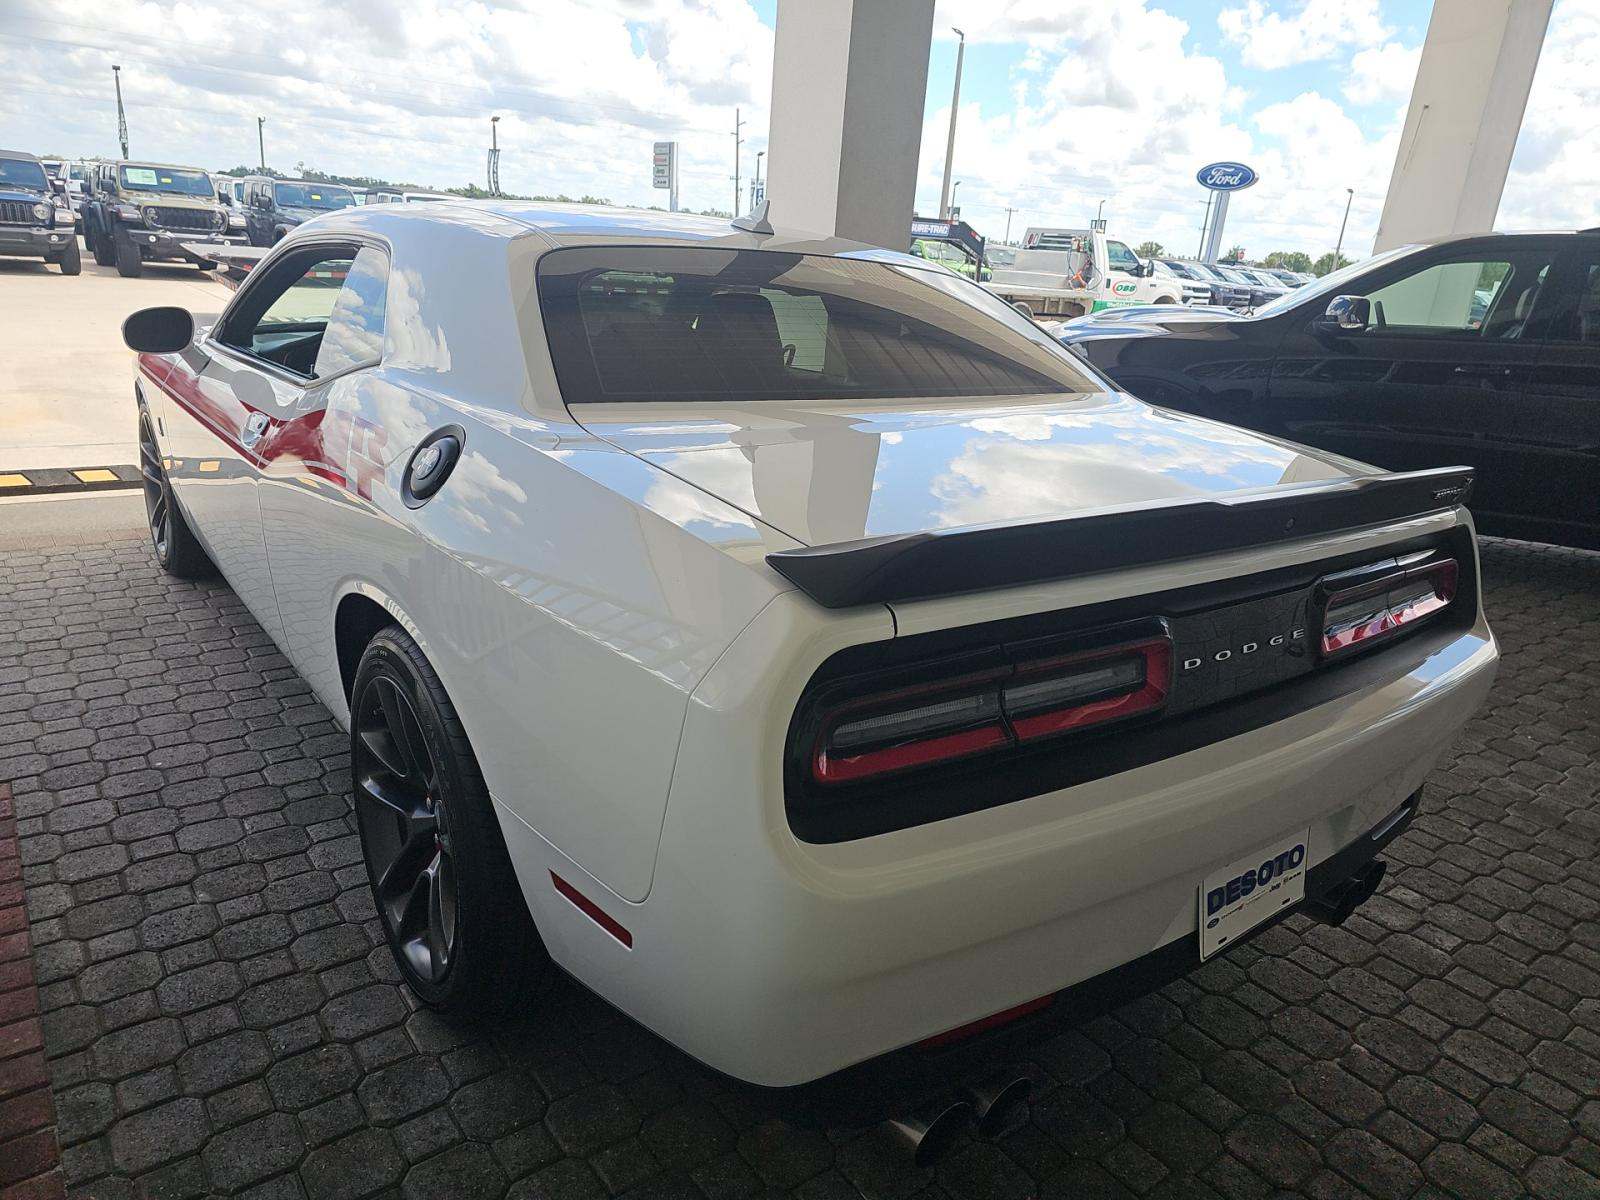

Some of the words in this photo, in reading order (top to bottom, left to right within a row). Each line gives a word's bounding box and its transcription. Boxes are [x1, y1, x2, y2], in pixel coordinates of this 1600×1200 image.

[1207, 167, 1242, 185] Ford
[1184, 628, 1305, 670] DODGE
[1207, 844, 1305, 916] DESOTO
